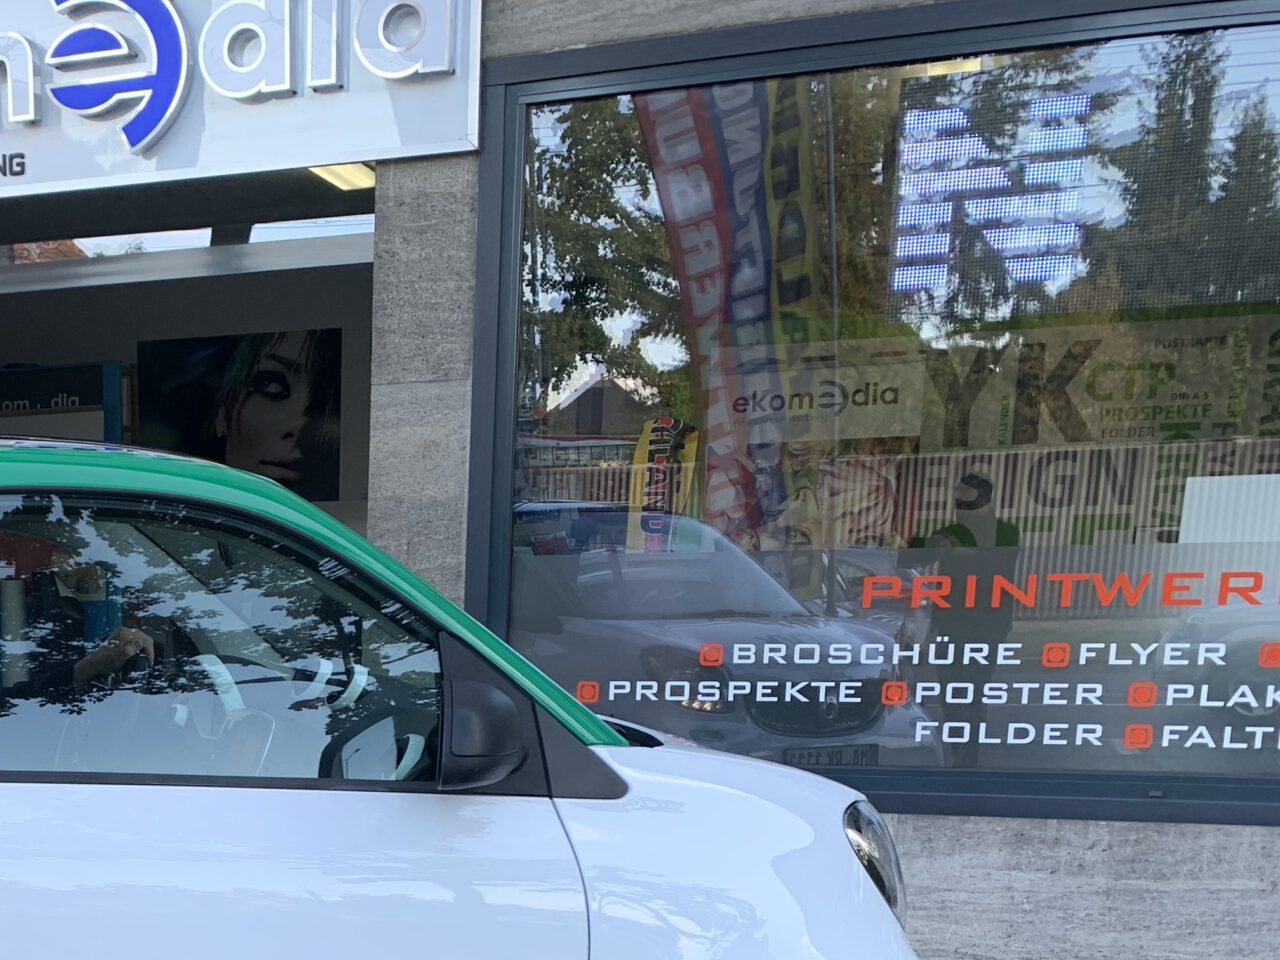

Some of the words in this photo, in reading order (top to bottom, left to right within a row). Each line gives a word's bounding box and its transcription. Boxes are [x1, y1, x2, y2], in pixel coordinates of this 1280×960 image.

[1101, 404, 1213, 422] PROSPEKTE
[862, 571, 1280, 608] PRINTWER
[732, 636, 1023, 666] BROSCHÜRE
[1079, 642, 1227, 666] FLYER
[608, 680, 863, 703] PROSPEKTE
[915, 682, 1104, 706] POSTER
[915, 721, 1103, 747] FOLDER
[1161, 725, 1280, 749] FALT
